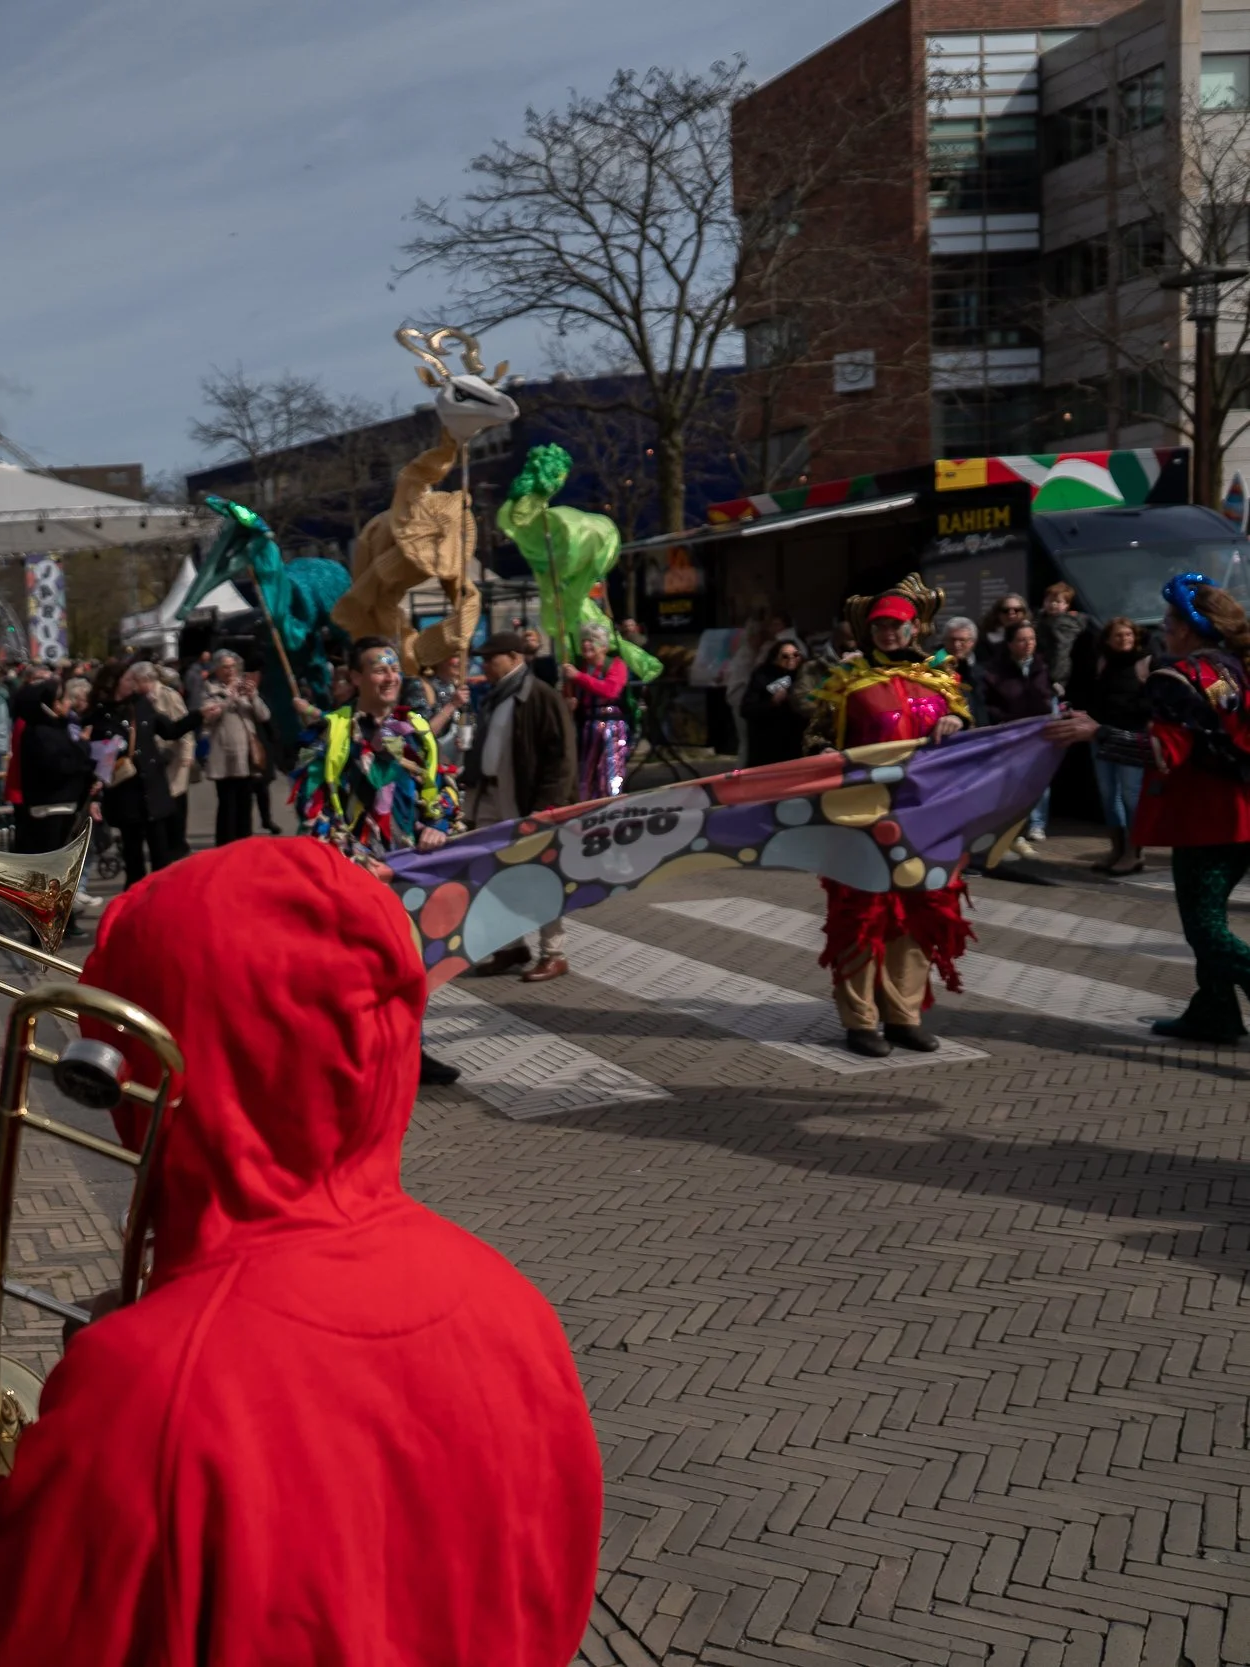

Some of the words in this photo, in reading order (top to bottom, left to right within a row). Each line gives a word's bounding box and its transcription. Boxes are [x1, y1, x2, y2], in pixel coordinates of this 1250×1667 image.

[938, 505, 1011, 535] RAHIEM
[40, 564, 59, 659] JARIG
[582, 814, 680, 857] 800
